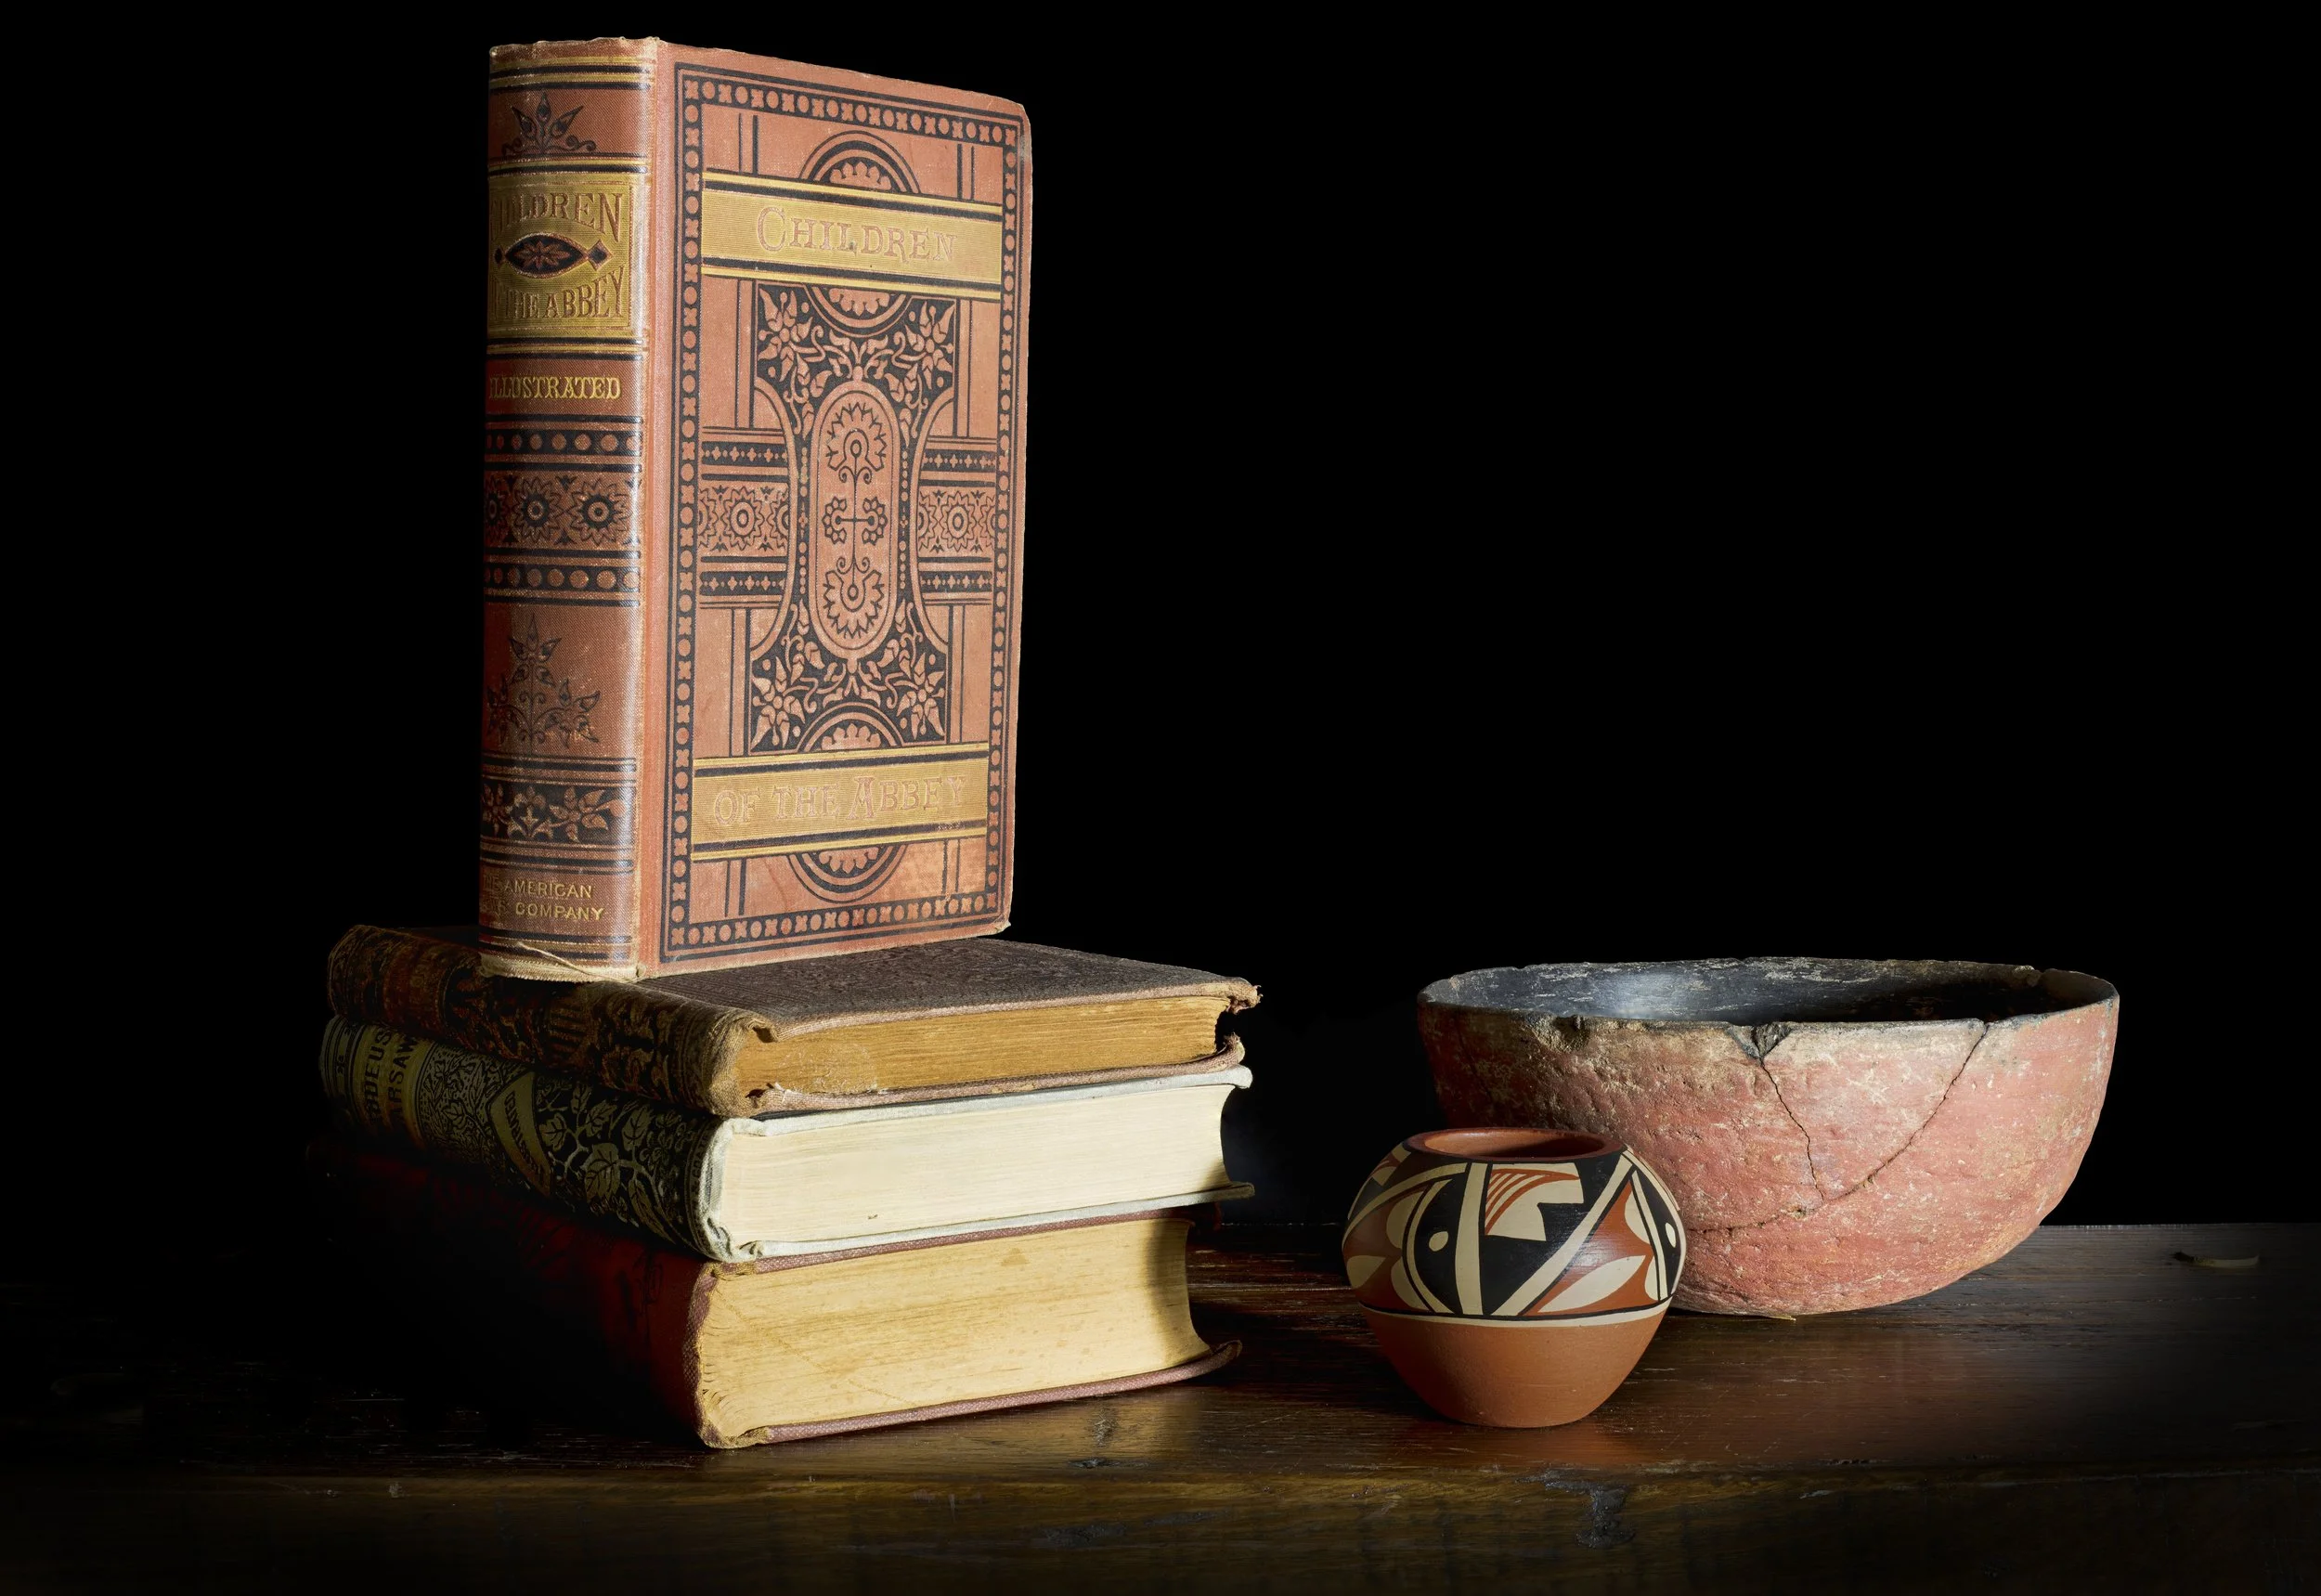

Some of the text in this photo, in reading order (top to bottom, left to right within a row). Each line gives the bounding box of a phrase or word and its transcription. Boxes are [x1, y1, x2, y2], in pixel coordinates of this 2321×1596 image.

[756, 206, 957, 264] CHILDREN
[542, 265, 626, 319] ABBEY
[489, 375, 622, 400] ILLUSTRATED
[714, 774, 966, 826] OF THE ABBEY
[504, 879, 592, 899] AMERICAN
[515, 902, 604, 922] COMPANY
